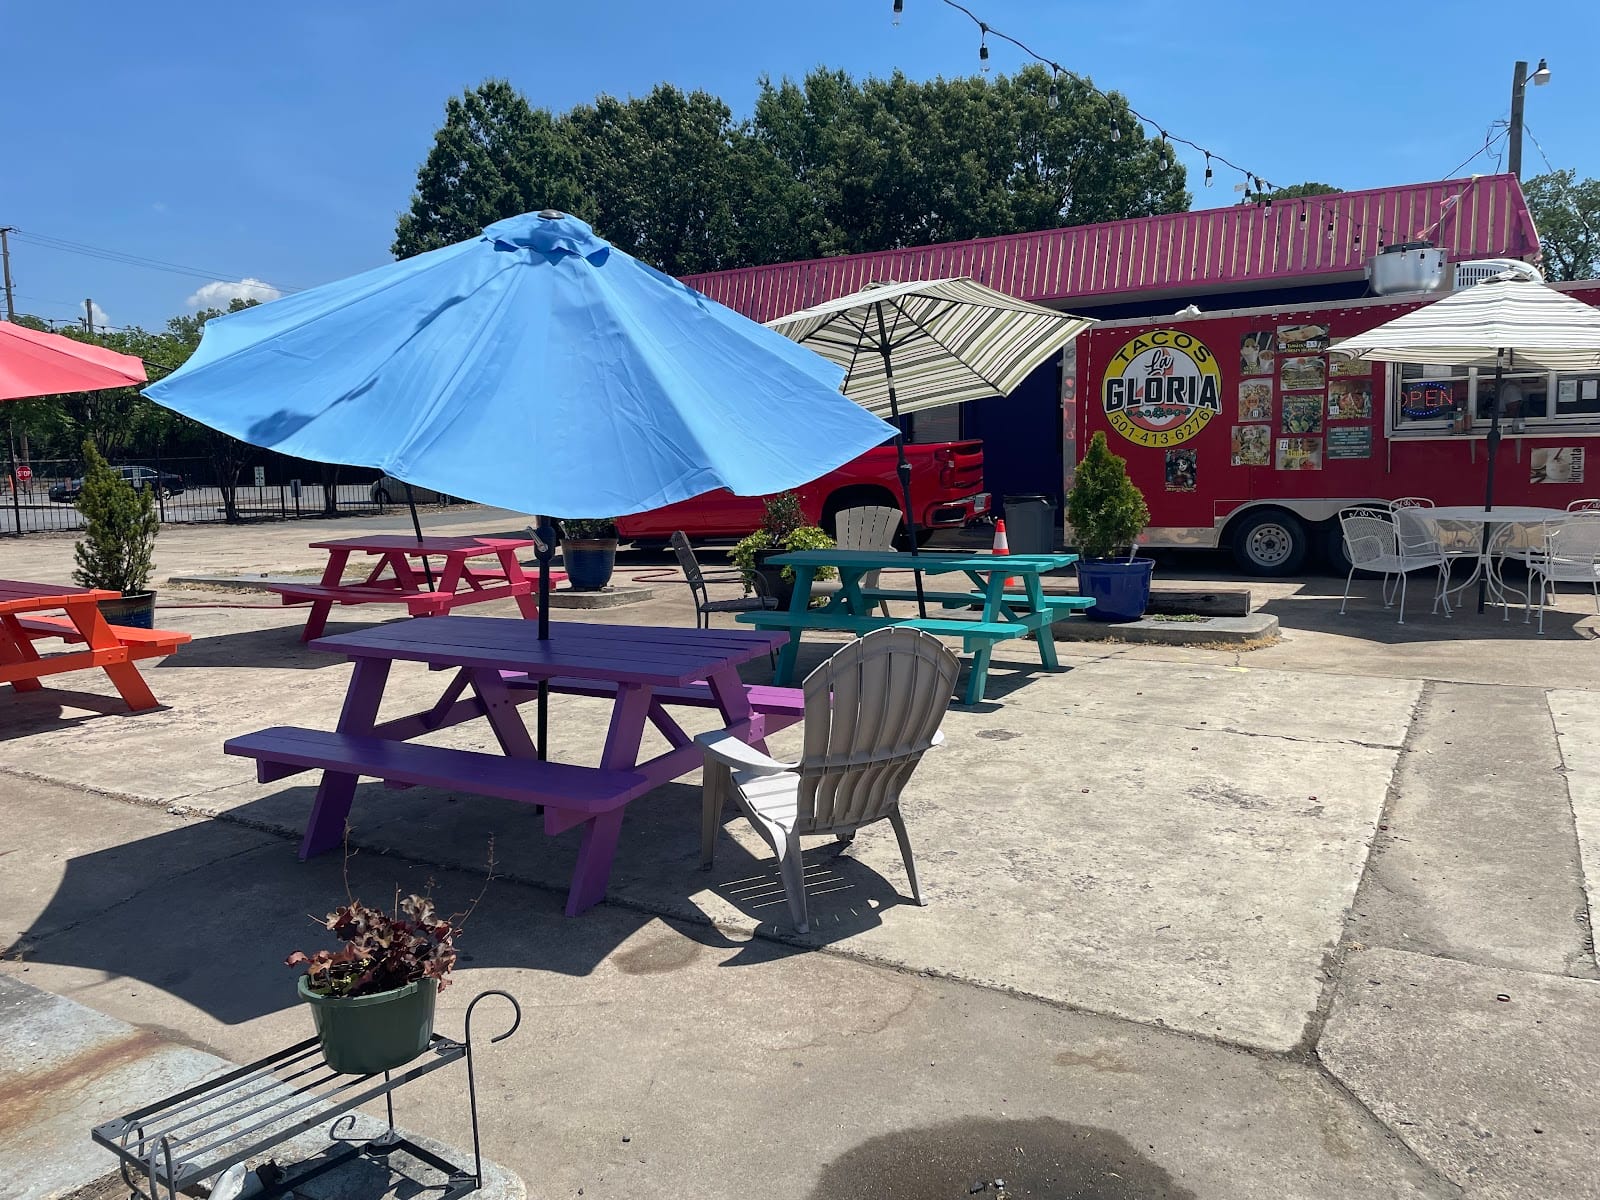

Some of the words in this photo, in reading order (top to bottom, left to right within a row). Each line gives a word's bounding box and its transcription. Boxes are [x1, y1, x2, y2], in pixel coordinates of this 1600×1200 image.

[1114, 331, 1211, 363] TACOS
[1106, 375, 1221, 412] GLORIA
[1111, 410, 1210, 445] 501-413-6276
[1568, 447, 1582, 483] Horchata
